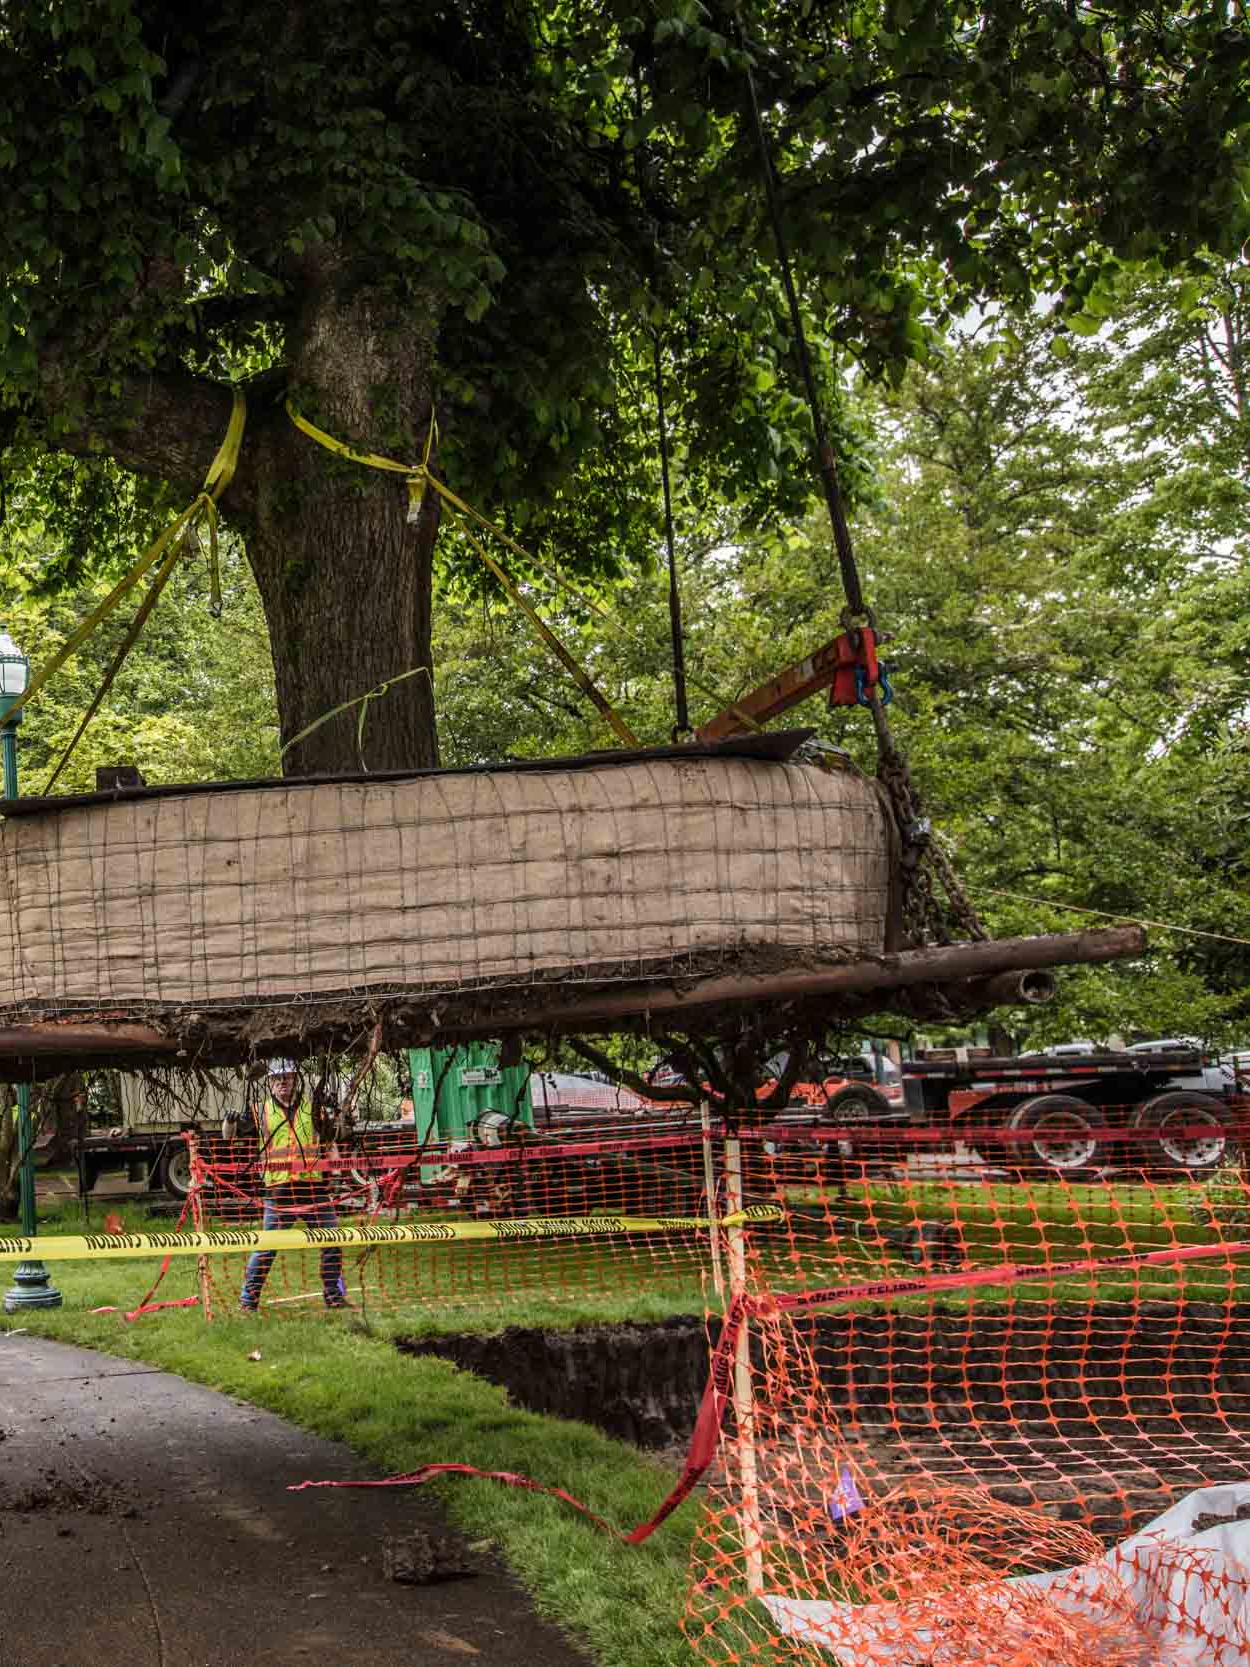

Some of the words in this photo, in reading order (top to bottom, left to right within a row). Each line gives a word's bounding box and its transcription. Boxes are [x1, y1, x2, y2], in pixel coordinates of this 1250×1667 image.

[82, 1232, 141, 1249] CAUTION
[144, 1231, 201, 1248] CAUTION
[205, 1230, 259, 1246] CAUTION
